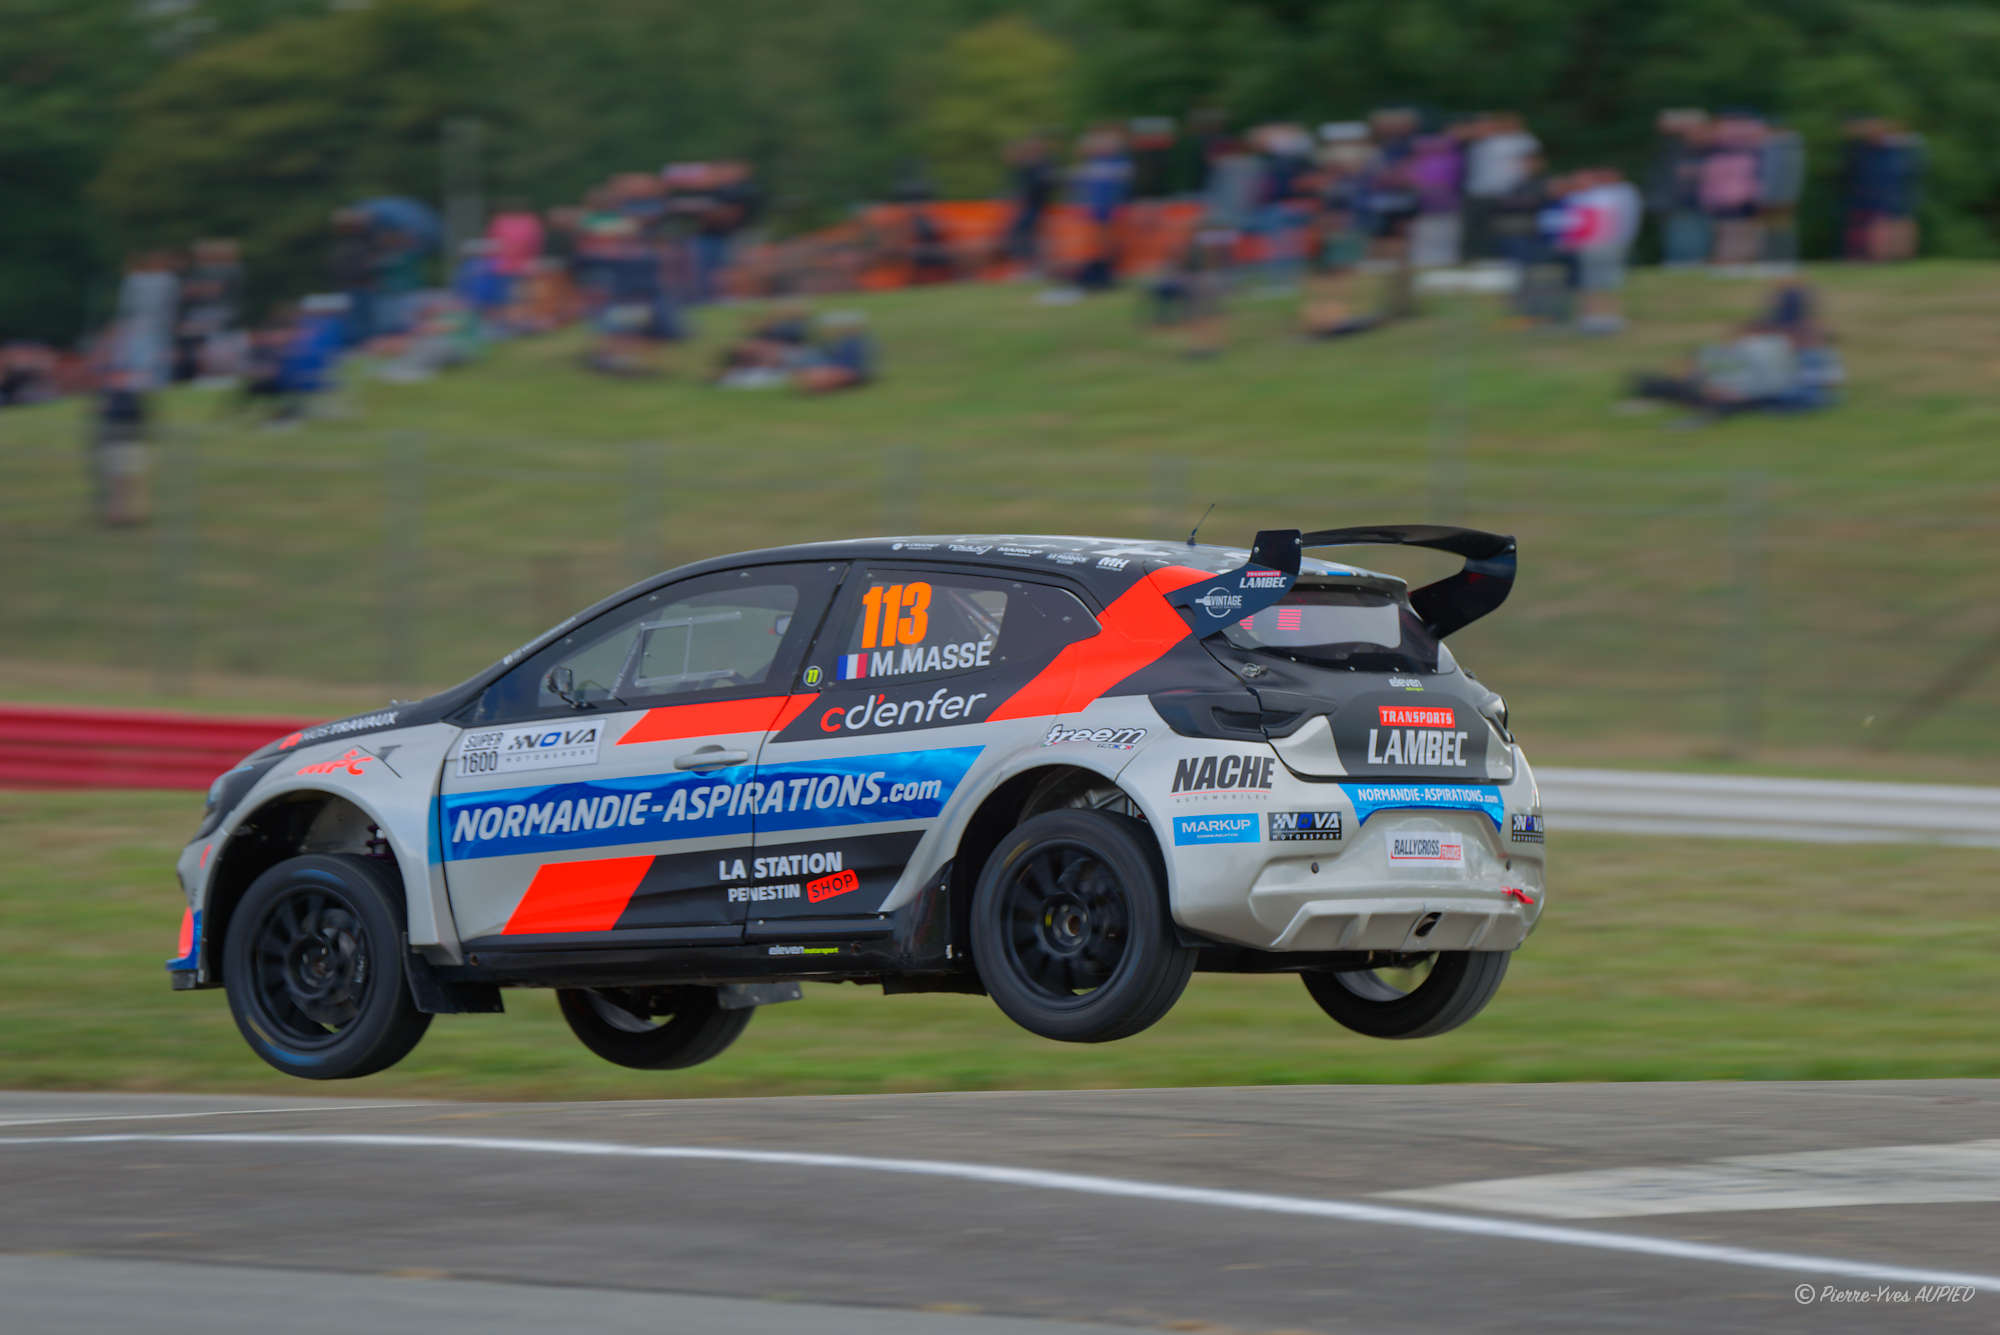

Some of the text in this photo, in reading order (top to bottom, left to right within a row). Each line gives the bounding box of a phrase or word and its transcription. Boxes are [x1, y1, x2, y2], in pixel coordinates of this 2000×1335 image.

[1240, 577, 1287, 588] LAMBEC
[1210, 596, 1242, 606] VINTAGE
[861, 582, 932, 648] 113
[870, 633, 993, 677] M.MASSÉ
[1389, 676, 1423, 688] eleven
[820, 688, 987, 732] cd'enfer
[1381, 710, 1453, 725] TRANSPORTS
[465, 732, 504, 748] SUPER
[1047, 723, 1148, 745] freem
[1368, 728, 1468, 767] LAMBEC
[462, 751, 499, 774] 1600
[1172, 755, 1276, 793] NACHE
[452, 772, 942, 842] NORMANDIE-ASPIRATIONS.com
[1358, 788, 1499, 804] NORMANDIE-ASPIRATIONS.com
[1182, 819, 1251, 833] MARKUP
[1394, 839, 1440, 856] RALLYCROSS
[719, 851, 843, 880] LA STATION
[728, 874, 853, 902] PENESTIN SHOP
